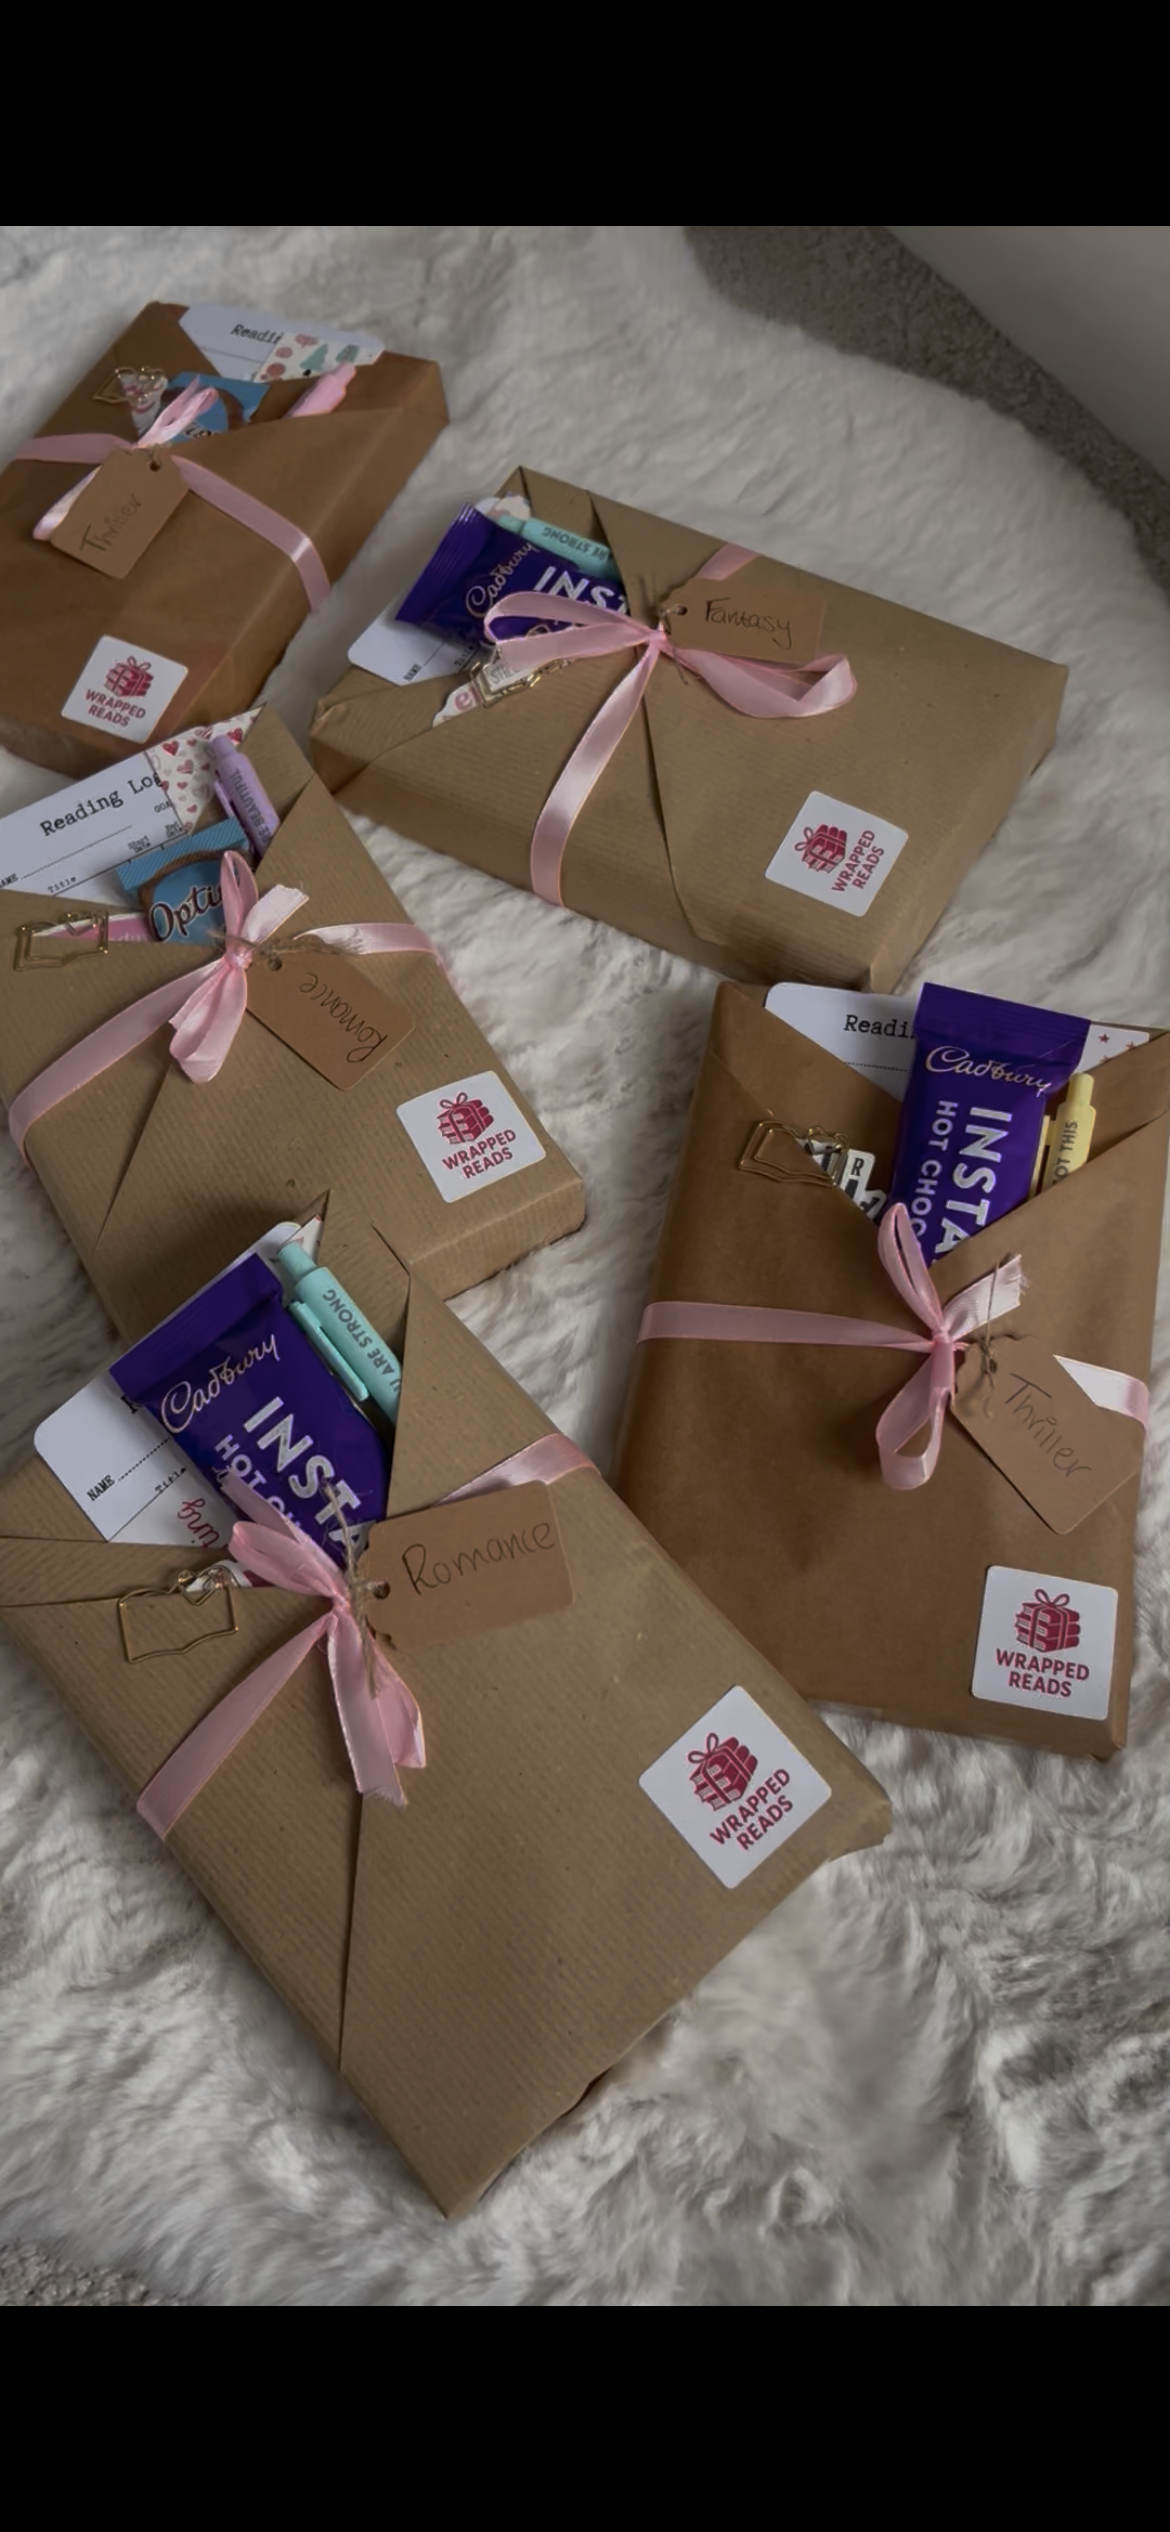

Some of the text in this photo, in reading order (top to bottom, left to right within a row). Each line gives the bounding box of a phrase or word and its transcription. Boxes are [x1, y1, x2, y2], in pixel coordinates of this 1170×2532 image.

[541, 526, 592, 553] STRONG
[466, 542, 540, 618] Cadbury
[533, 565, 629, 614] INS
[703, 599, 793, 650] Fantasy
[85, 688, 146, 720] WRAPPED
[87, 704, 131, 728] READS
[39, 770, 164, 837] Reading Log
[230, 768, 265, 828] BEAUTIFUL
[0, 873, 19, 889] AME
[48, 875, 77, 894] Title
[831, 829, 876, 894] WRAPPED
[853, 845, 885, 890] READS
[151, 884, 223, 942] Opti
[299, 972, 389, 1063] Romance
[843, 1014, 915, 1039] Readi
[925, 1045, 1052, 1098] Cadbury
[442, 1129, 517, 1171] WRAPPED
[462, 1145, 514, 1180] READS
[909, 1100, 959, 1237] HOT CHOC
[1052, 1121, 1079, 1186] OT THIS
[935, 1106, 1014, 1254] INSTA
[322, 1288, 396, 1375] ARE STRONG
[160, 1333, 281, 1434] Cadbury
[1004, 1372, 1092, 1478] Thriller
[86, 1474, 116, 1502] NAME
[214, 1434, 267, 1490] HOT
[177, 1498, 222, 1549] ting
[402, 1521, 557, 1595] Romance
[995, 1646, 1090, 1682] WRAPPED
[1008, 1672, 1073, 1699] READS
[709, 1767, 791, 1847] WRAPPED
[737, 1793, 795, 1851] READS
